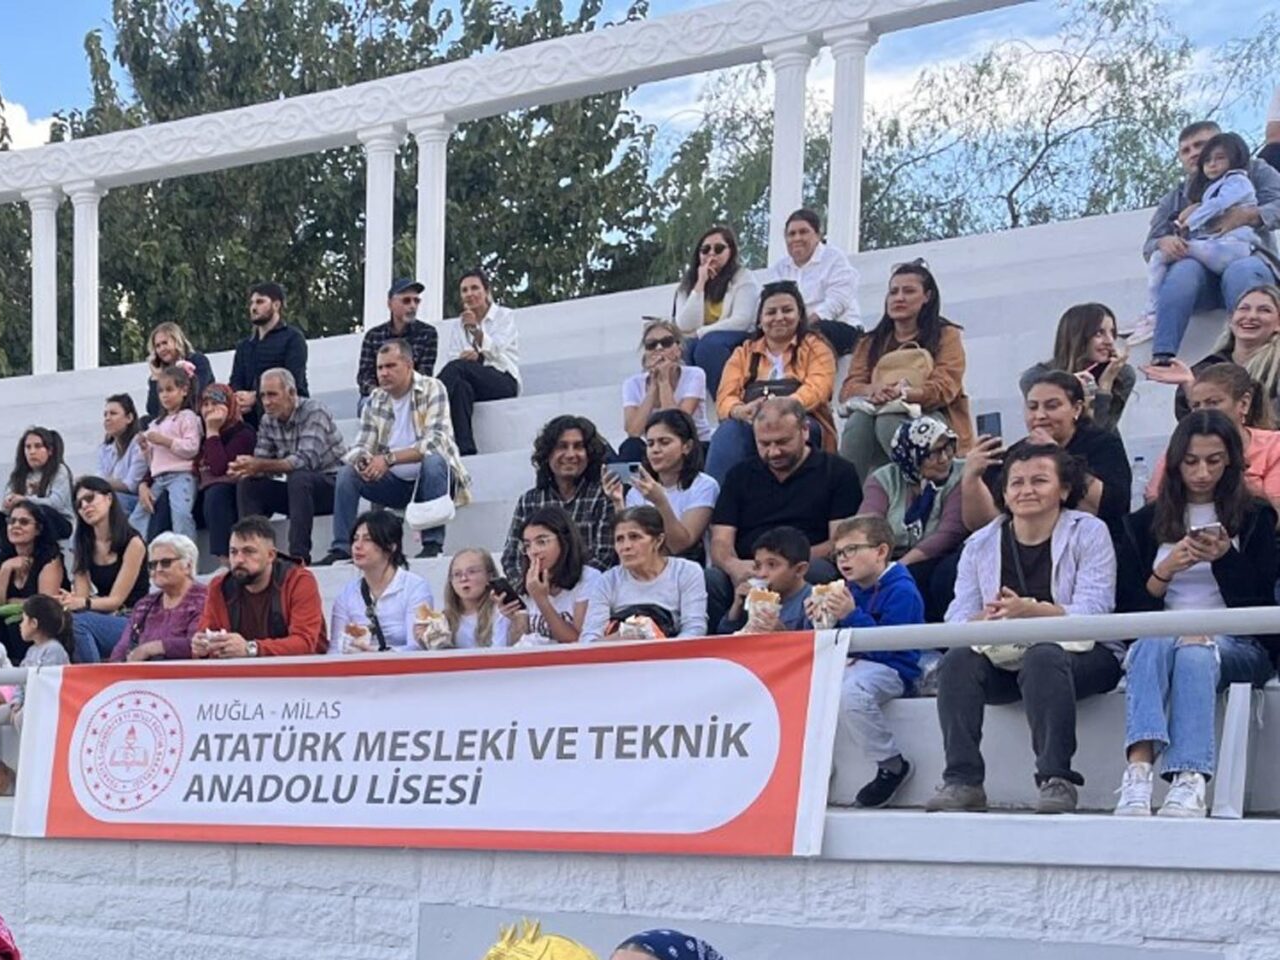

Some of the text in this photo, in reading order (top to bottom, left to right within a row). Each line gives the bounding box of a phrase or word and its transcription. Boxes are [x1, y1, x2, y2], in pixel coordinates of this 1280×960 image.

[196, 700, 265, 721] MUĞLA
[280, 698, 342, 720] MİLAS
[189, 725, 347, 762] ATATÜRK
[353, 721, 518, 762] MESLEKİ
[528, 726, 579, 760] VE
[588, 715, 752, 760] TEKNİK
[183, 767, 483, 805] ANADOLU LİSESİ
